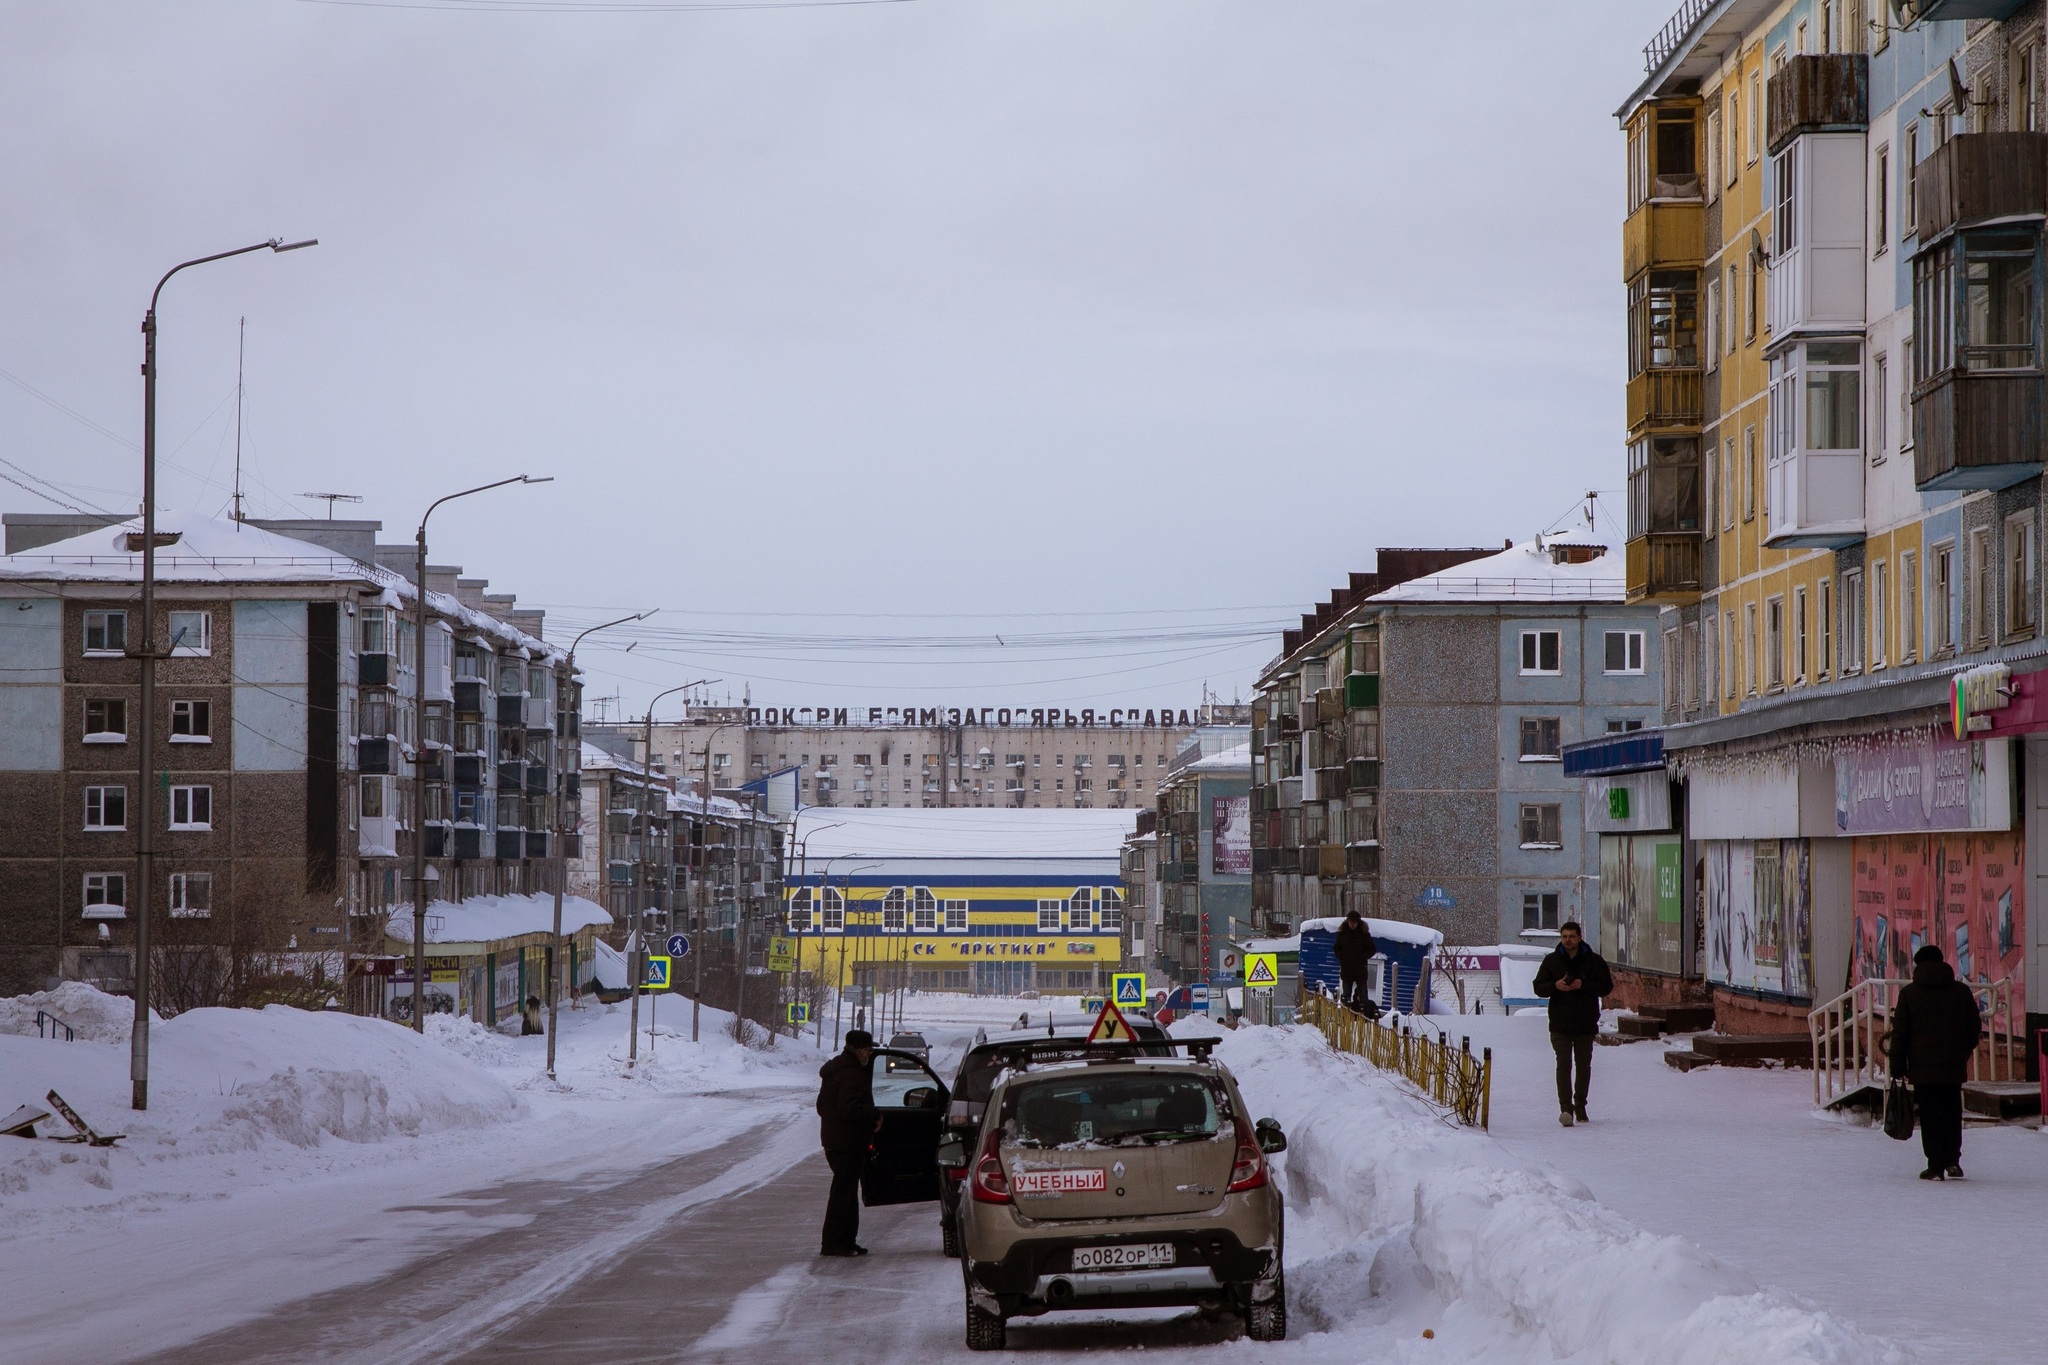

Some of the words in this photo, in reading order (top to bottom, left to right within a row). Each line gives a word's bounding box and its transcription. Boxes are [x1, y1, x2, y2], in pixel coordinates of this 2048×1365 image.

[1661, 867, 1676, 898] SELA
[913, 942, 937, 955] СК
[1104, 1020, 1118, 1038] У
[1018, 1170, 1103, 1189] УЧЕБНЫЙ
